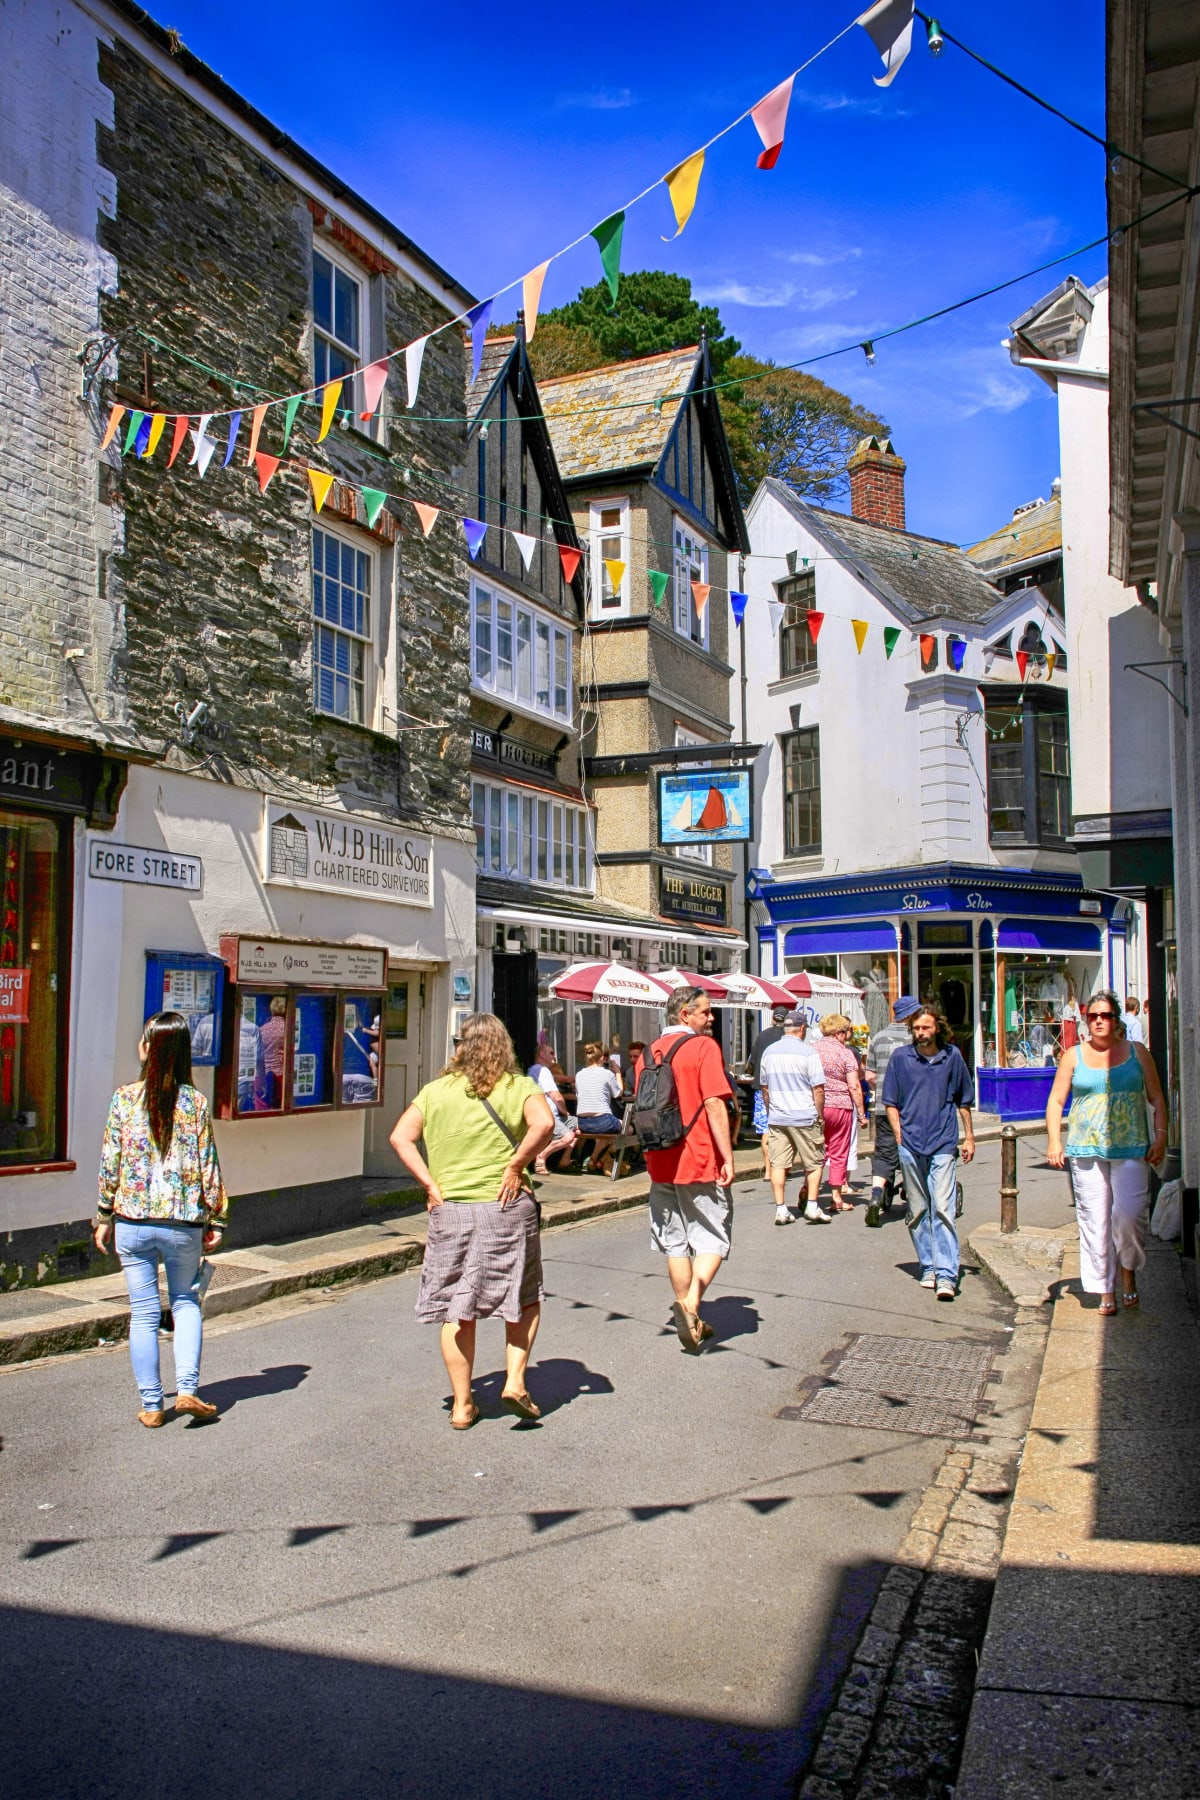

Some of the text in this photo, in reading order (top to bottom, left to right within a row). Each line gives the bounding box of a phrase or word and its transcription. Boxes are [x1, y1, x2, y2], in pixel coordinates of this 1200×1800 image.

[1, 758, 55, 791] ant
[95, 850, 196, 882] FORE STREET
[369, 832, 395, 867] Hill
[395, 847, 404, 866] &
[404, 841, 429, 874] Son
[314, 860, 429, 895] CHARTERED SURVEYORS
[665, 876, 723, 902] THE LUGGER
[681, 901, 704, 913] AUSTELL
[293, 959, 309, 968] RICS
[628, 997, 659, 1008] Earned
